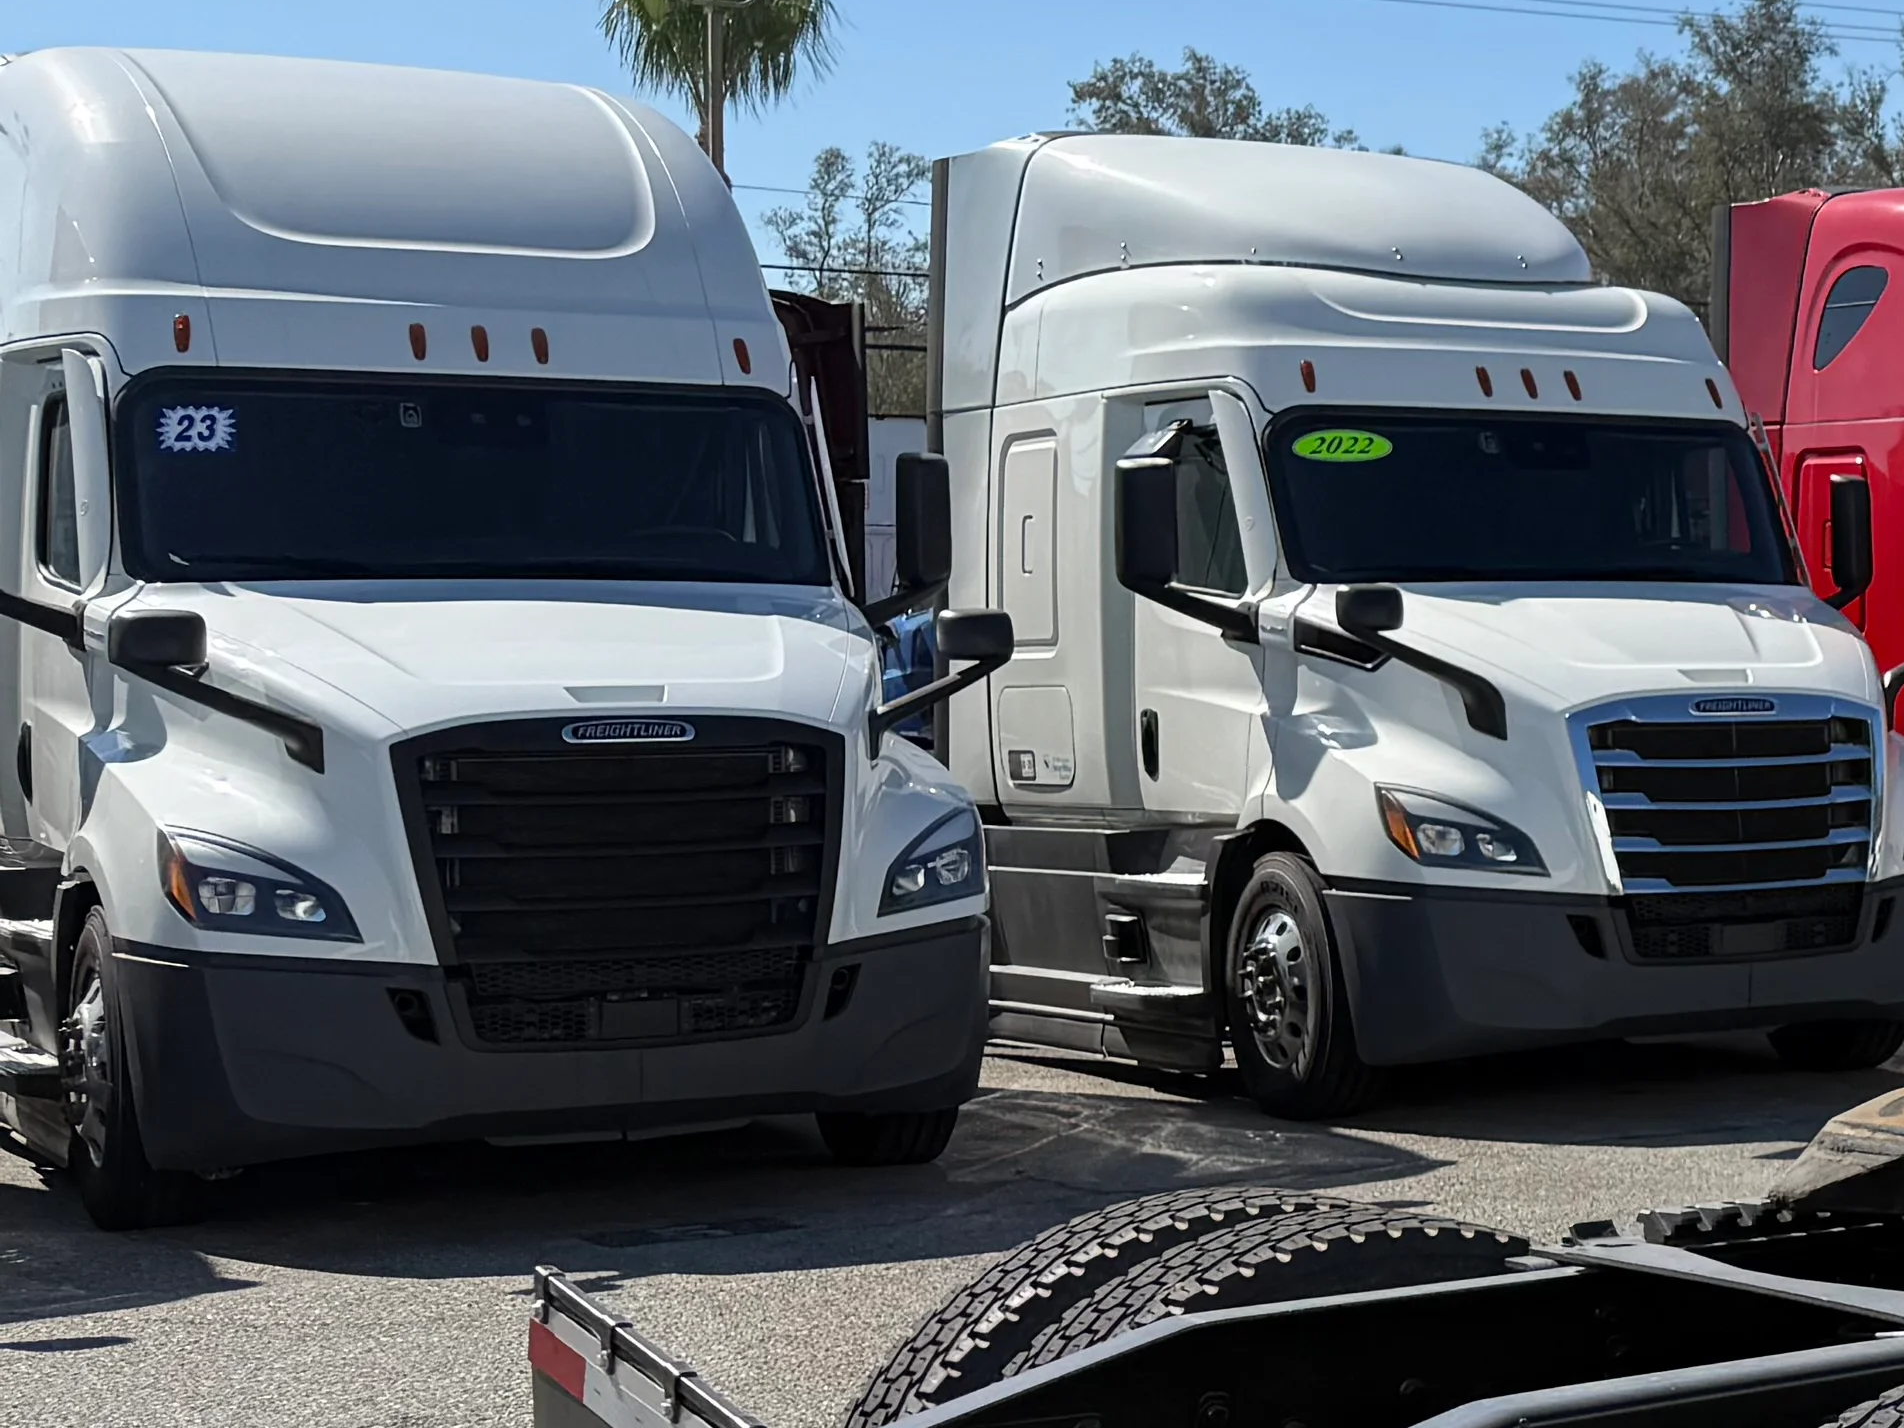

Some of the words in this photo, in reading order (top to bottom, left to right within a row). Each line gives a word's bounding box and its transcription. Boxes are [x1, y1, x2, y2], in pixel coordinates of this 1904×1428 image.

[174, 414, 217, 442] 23
[1309, 436, 1375, 455] 2022
[577, 723, 682, 738] FREIGHTLINER
